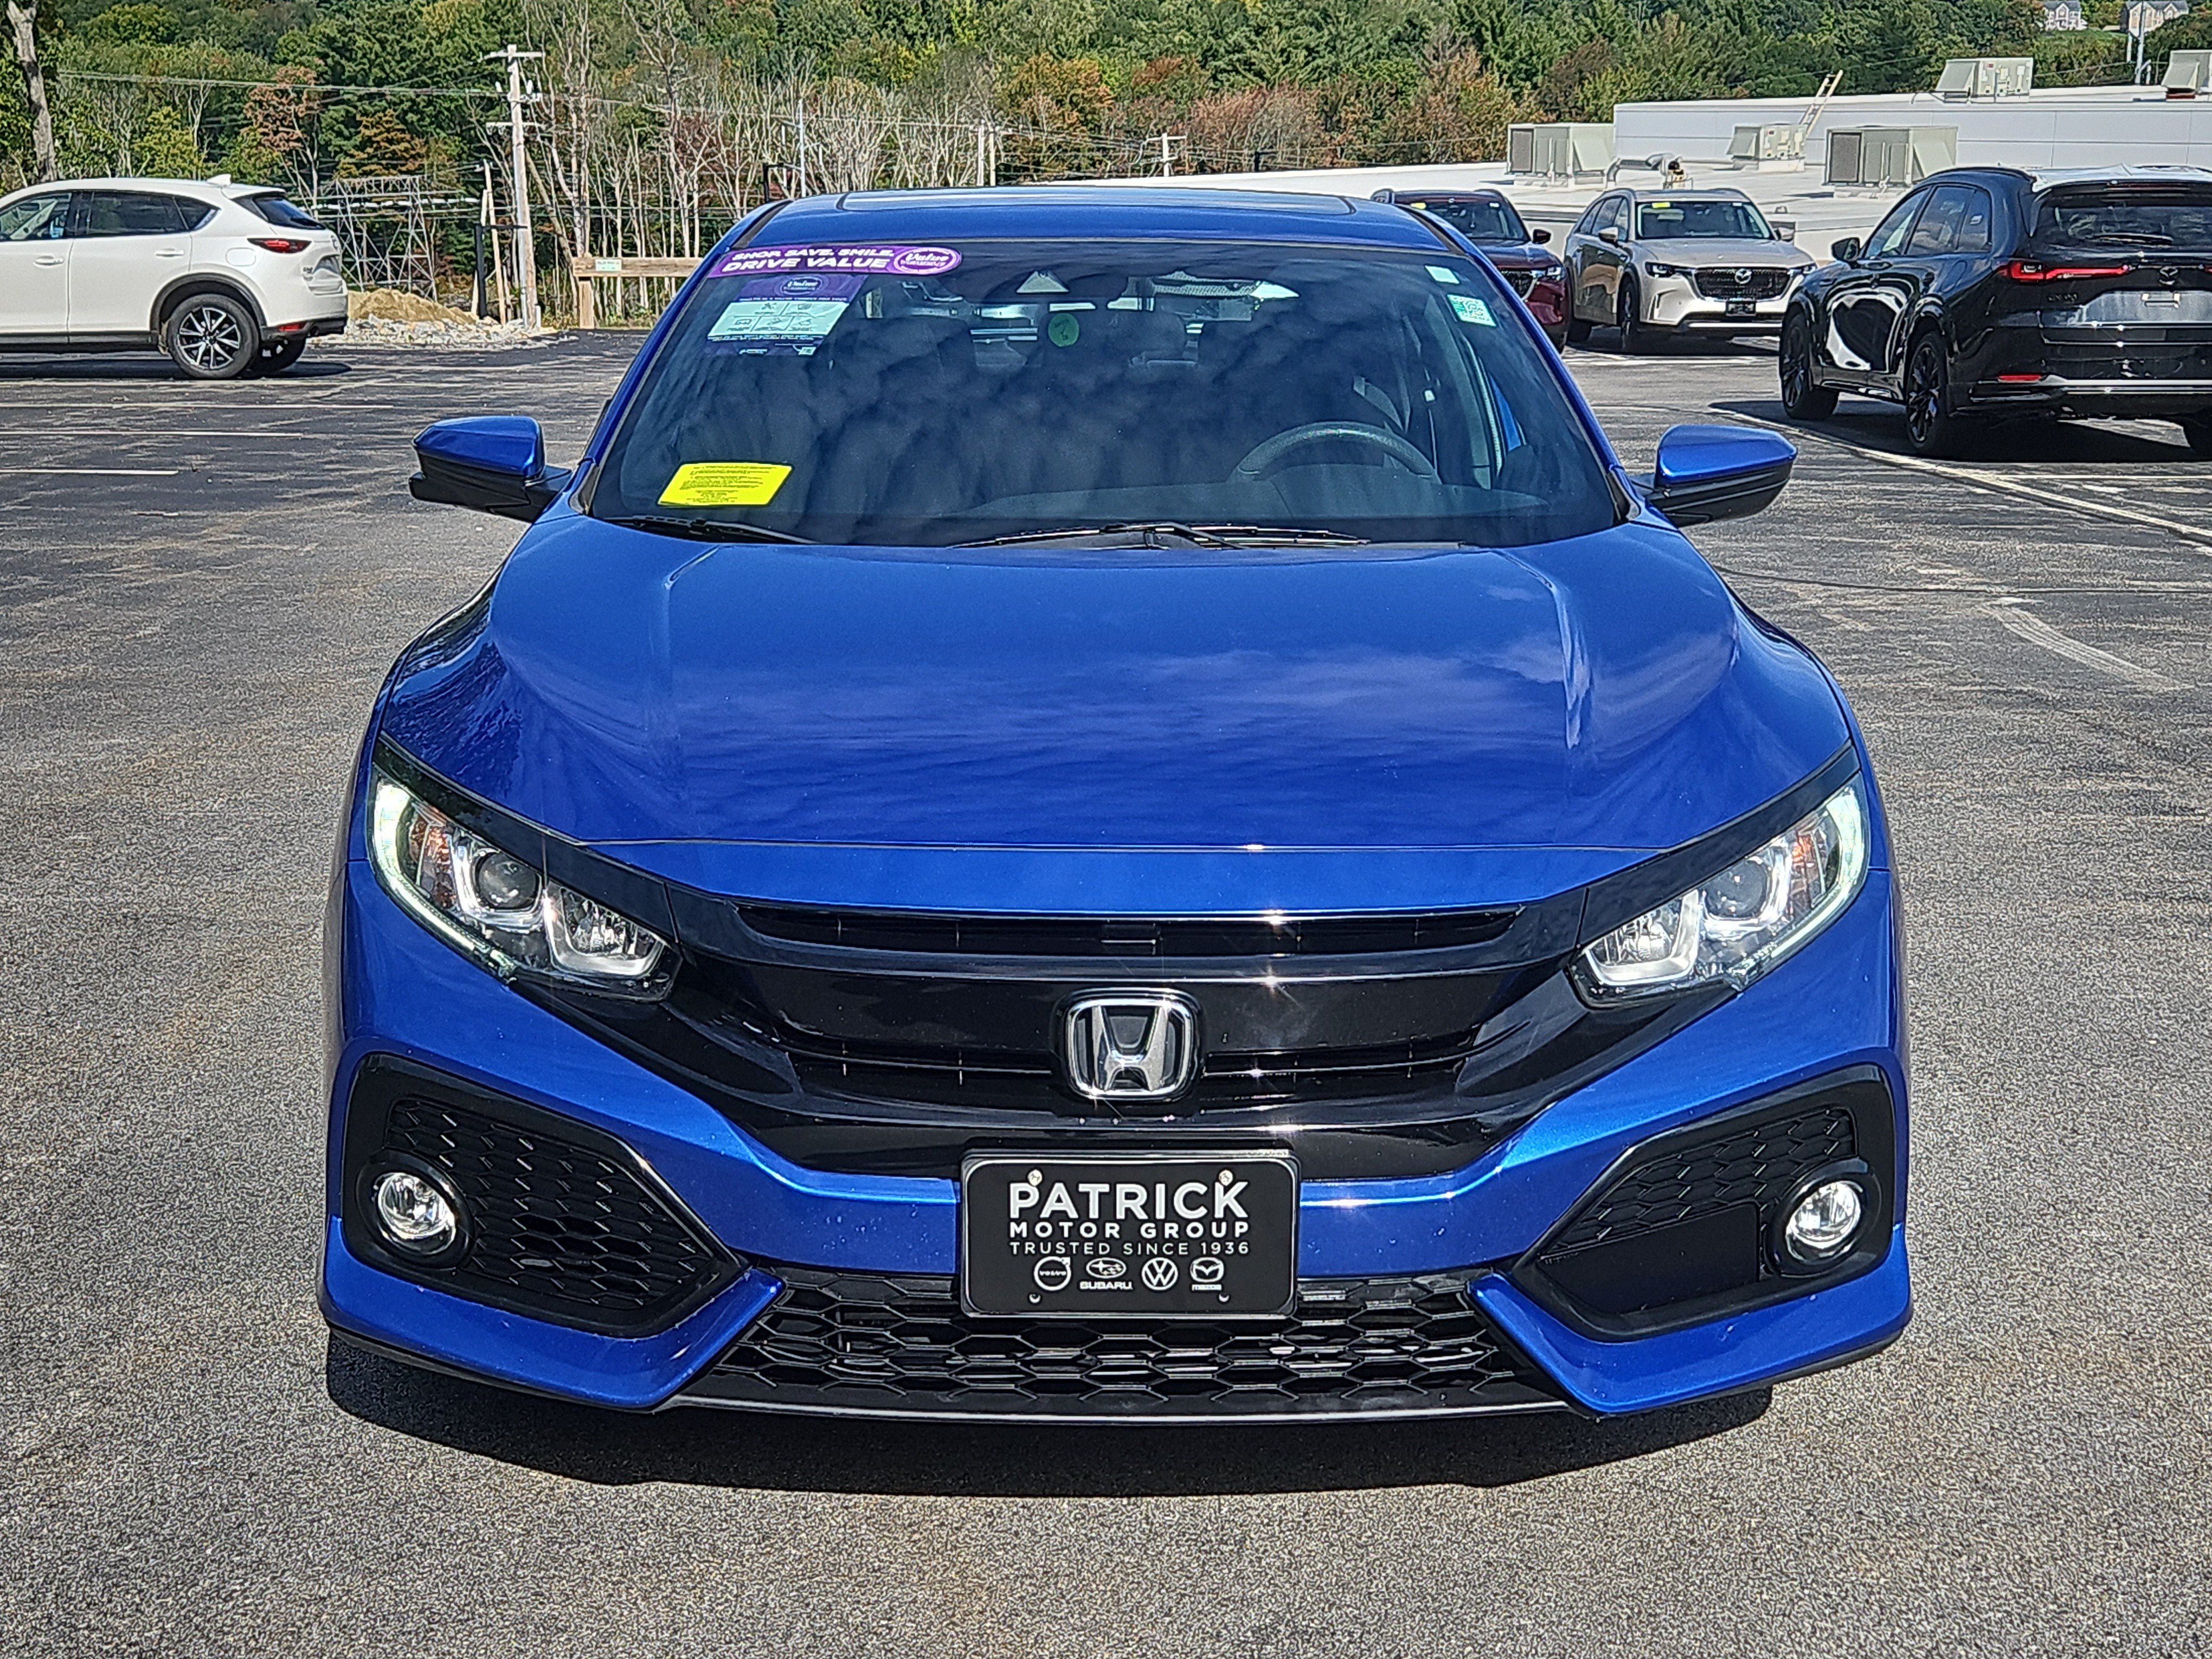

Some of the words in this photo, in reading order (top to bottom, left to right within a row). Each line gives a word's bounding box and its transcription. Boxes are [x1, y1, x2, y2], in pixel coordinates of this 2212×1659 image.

[722, 258, 801, 272] DRIVE
[807, 256, 891, 268] VALUE
[1009, 1182, 1249, 1220] PATRICK
[1009, 1221, 1120, 1239] MOTOR
[1140, 1221, 1249, 1239] GROUP
[1009, 1242, 1110, 1255] TRUSTED
[1123, 1242, 1189, 1255] SINCE
[1201, 1242, 1249, 1255] 1936
[1079, 1281, 1134, 1290] SUBARU
